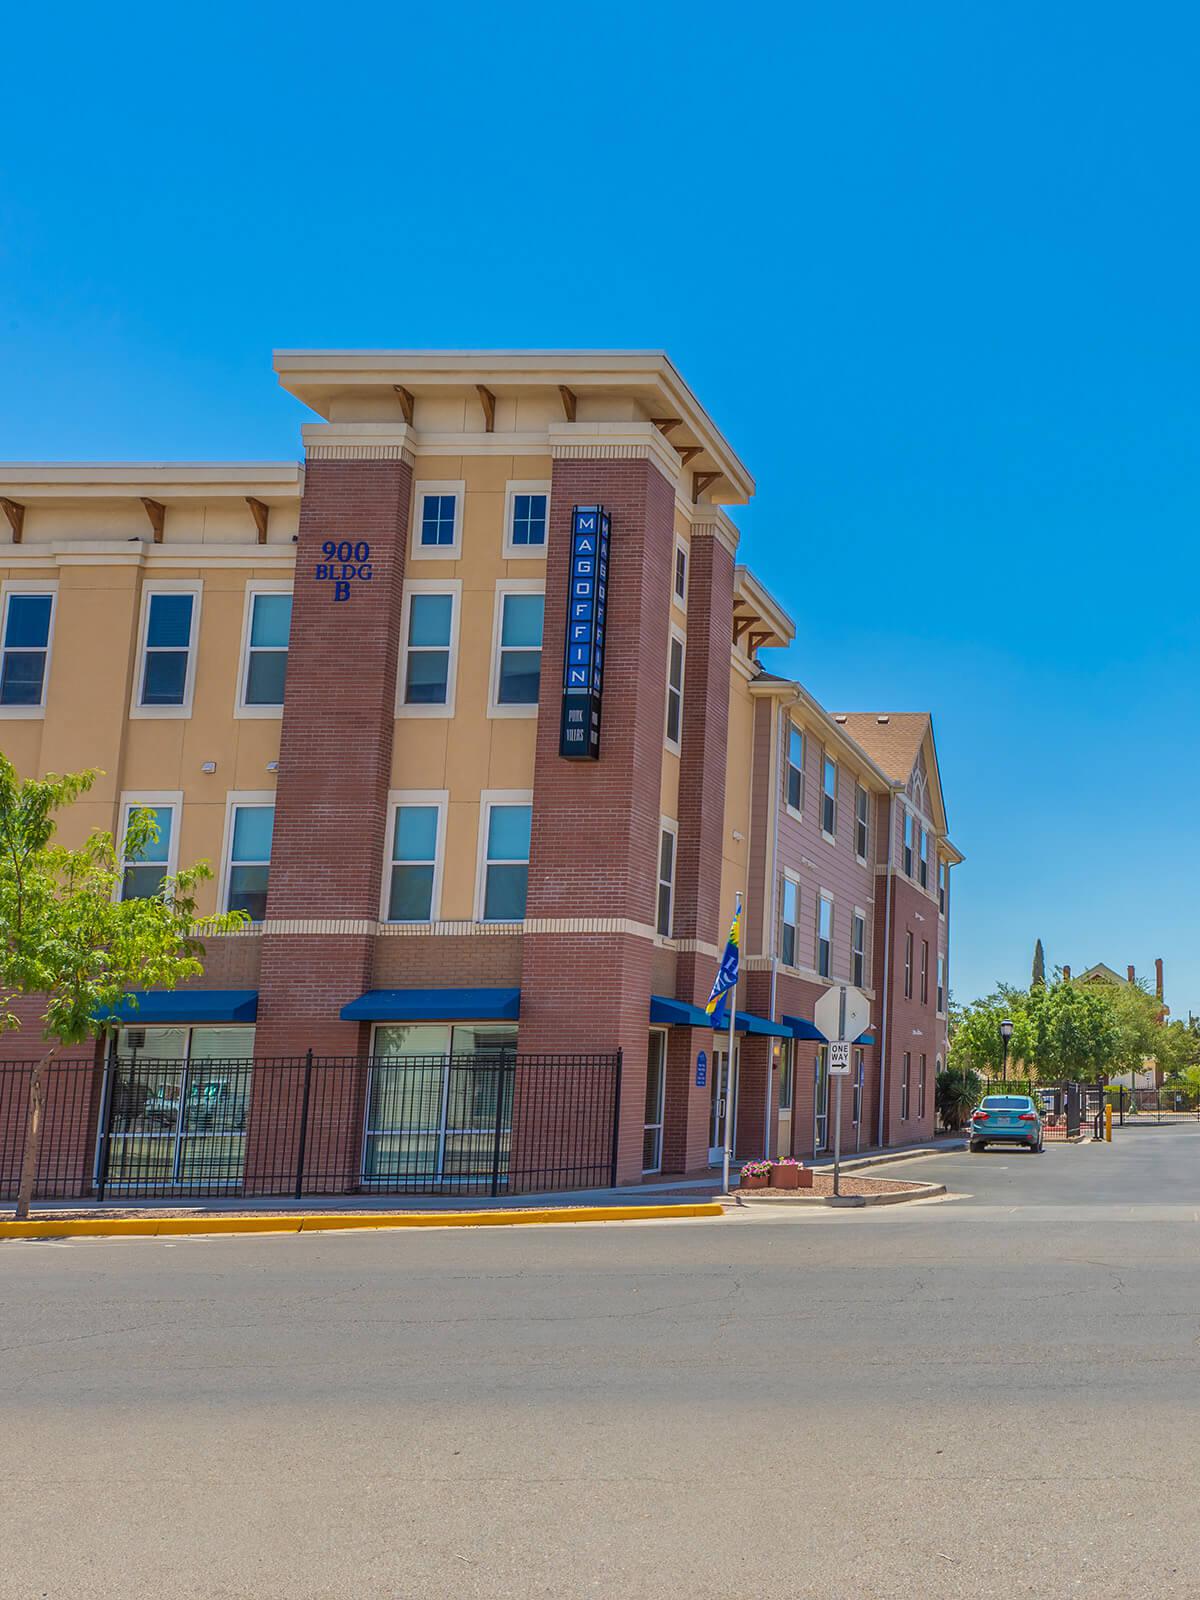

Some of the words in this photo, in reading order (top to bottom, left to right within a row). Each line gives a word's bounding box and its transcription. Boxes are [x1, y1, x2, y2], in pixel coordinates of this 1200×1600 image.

[322, 541, 370, 562] 900
[315, 564, 373, 580] BLDG
[335, 580, 351, 602] B
[571, 518, 594, 682] MAGOFFIN
[832, 1045, 848, 1053] ONE
[832, 1053, 848, 1061] WAY
